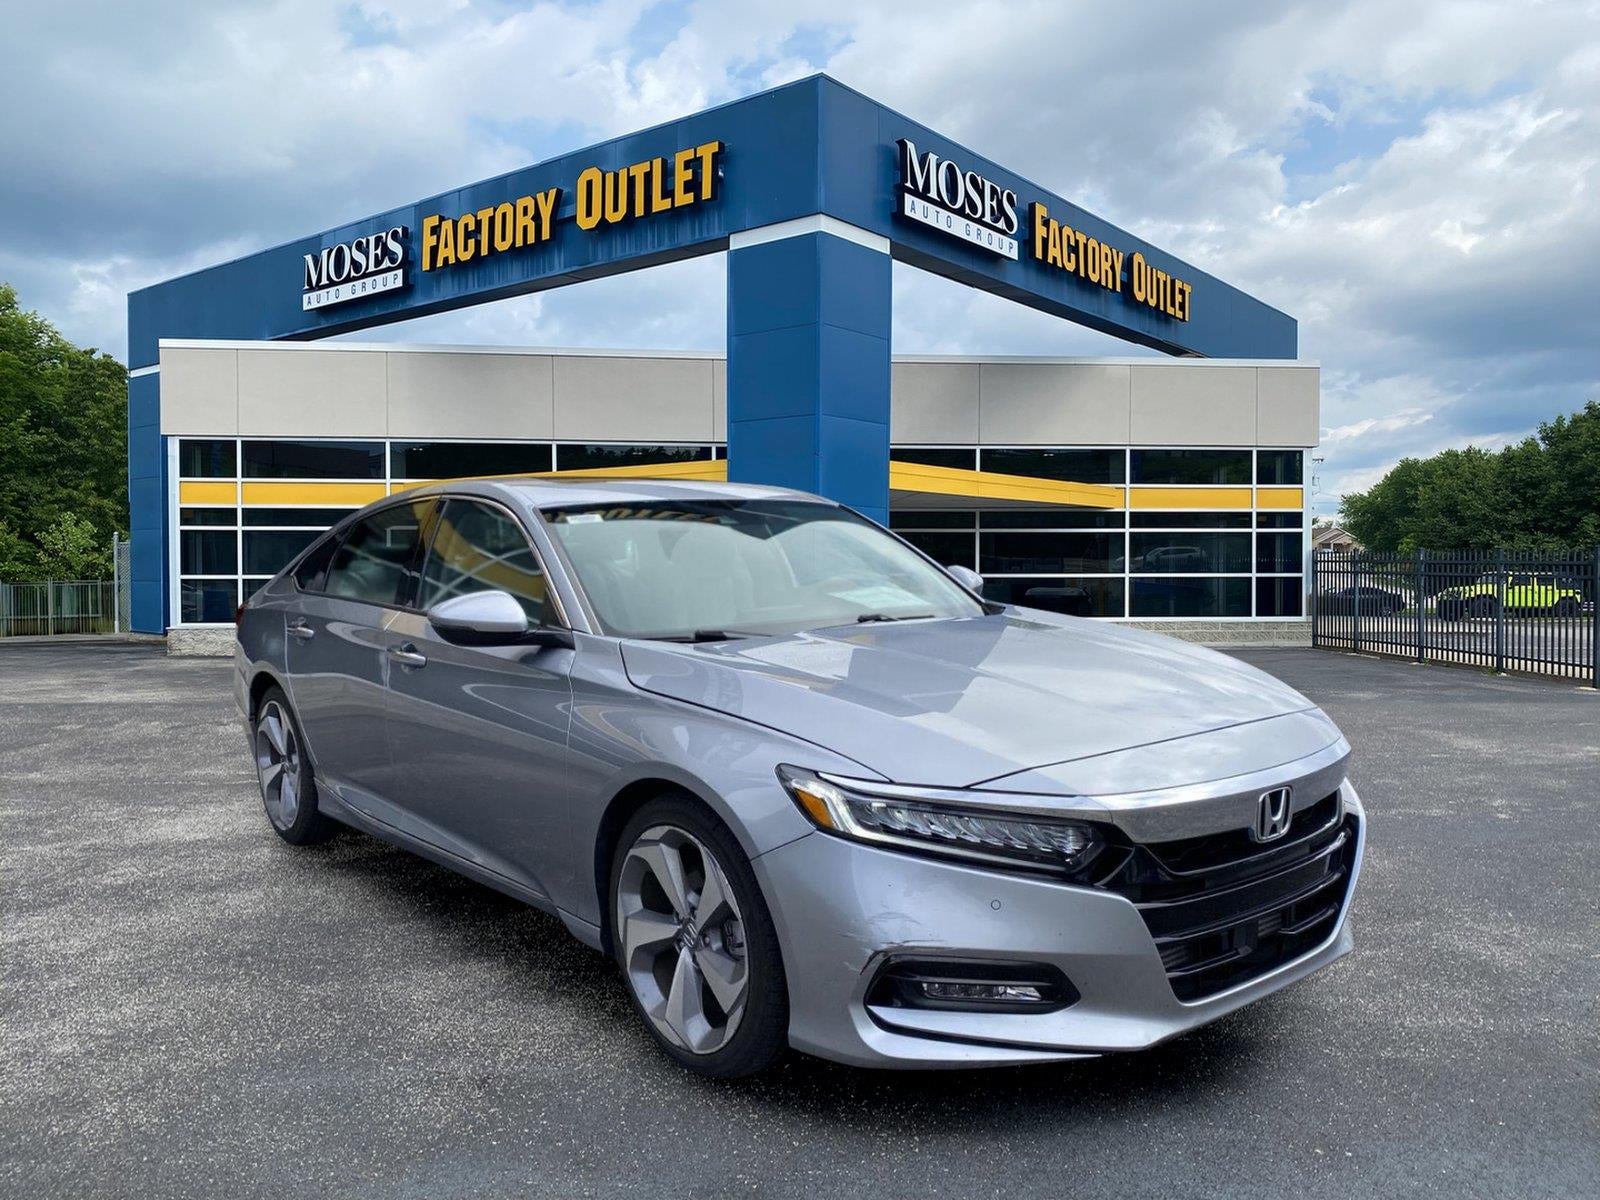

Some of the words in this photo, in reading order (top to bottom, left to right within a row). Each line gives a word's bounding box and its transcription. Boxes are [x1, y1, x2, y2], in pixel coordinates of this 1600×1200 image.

[422, 187, 558, 271] FACTORY
[577, 140, 719, 231] OUTLET
[904, 139, 1018, 235] MOSES
[910, 200, 952, 229] AUTO
[965, 223, 1014, 253] GROUP
[303, 226, 403, 290] MOSES
[307, 288, 340, 306] AUTO
[351, 273, 399, 295] GROUP
[1034, 202, 1123, 292] FACTORY
[1133, 252, 1192, 322] OUTLET
